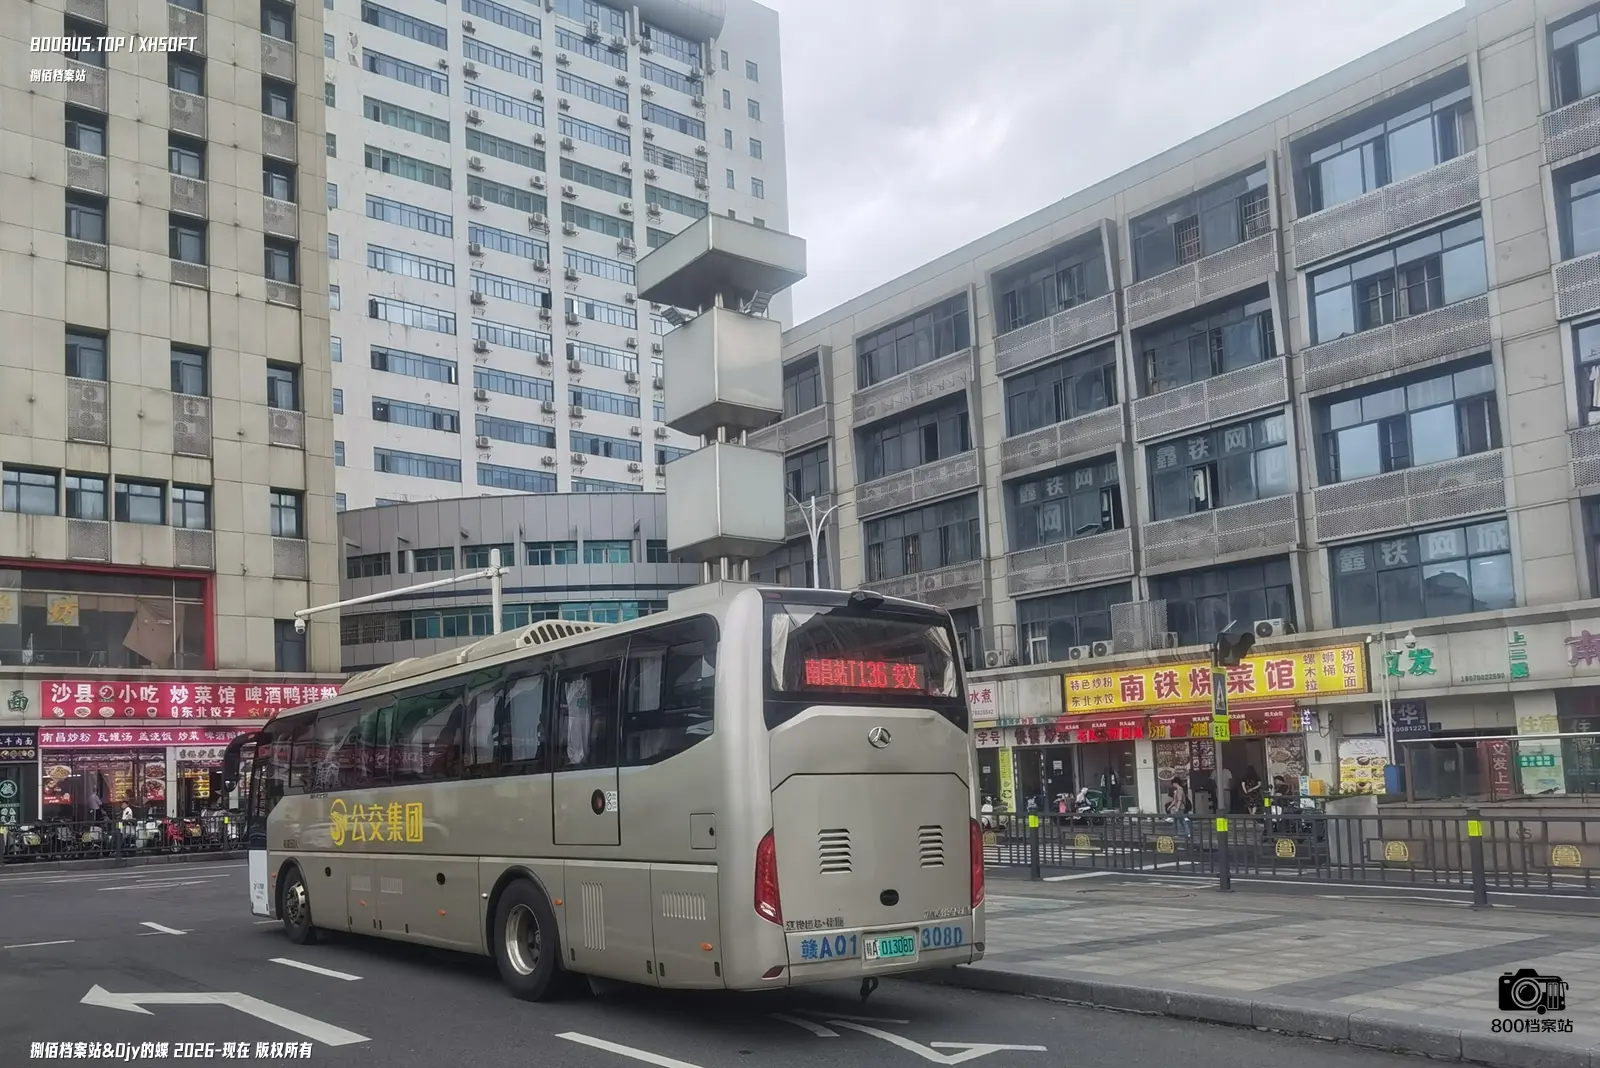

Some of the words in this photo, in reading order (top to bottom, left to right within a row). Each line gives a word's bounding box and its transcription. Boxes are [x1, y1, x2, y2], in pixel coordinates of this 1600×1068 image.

[1303, 649, 1355, 665] 螺蛳粉
[1304, 662, 1356, 678] 木桶饭
[1070, 677, 1112, 691] 特色炒粉
[1119, 660, 1295, 702] 南铁烧菜馆
[51, 683, 95, 703] 沙县
[118, 684, 159, 704] 小吃
[169, 684, 236, 705] 炒菜馆
[969, 688, 992, 705] 水煮
[1071, 693, 1114, 707] 东北水饺
[181, 706, 235, 718] 东北饺子
[0, 736, 33, 746] 牛肉面
[41, 732, 91, 742] 南昌炒粉
[177, 731, 199, 741] 炒菜
[977, 731, 1000, 746] 字号
[351, 802, 423, 843] 公交集团
[801, 934, 857, 959] 赣A01
[922, 926, 963, 948] 308D
